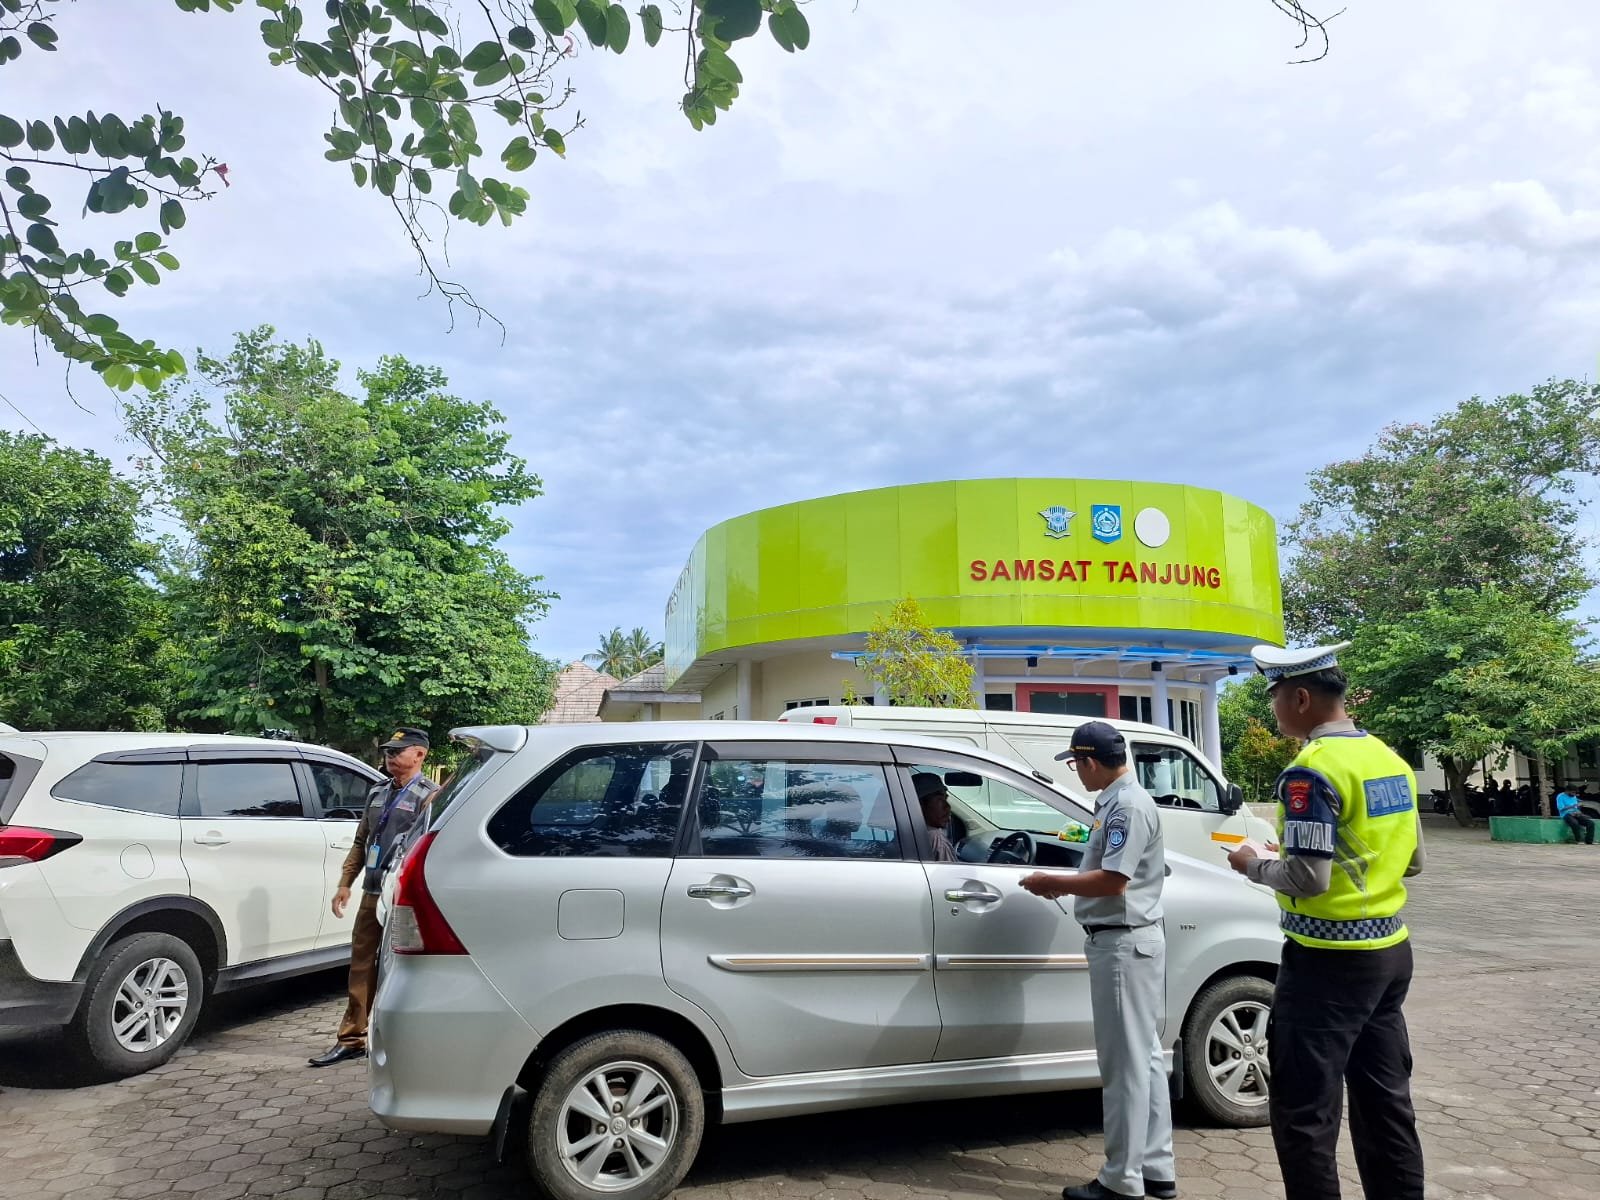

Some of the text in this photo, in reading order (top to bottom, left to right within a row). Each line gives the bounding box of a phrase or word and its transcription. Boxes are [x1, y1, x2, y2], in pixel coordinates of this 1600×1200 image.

[970, 559, 1221, 589] SAMSAT TANJUNG
[1367, 779, 1411, 810] POLIS
[1284, 820, 1334, 852] TWAL
